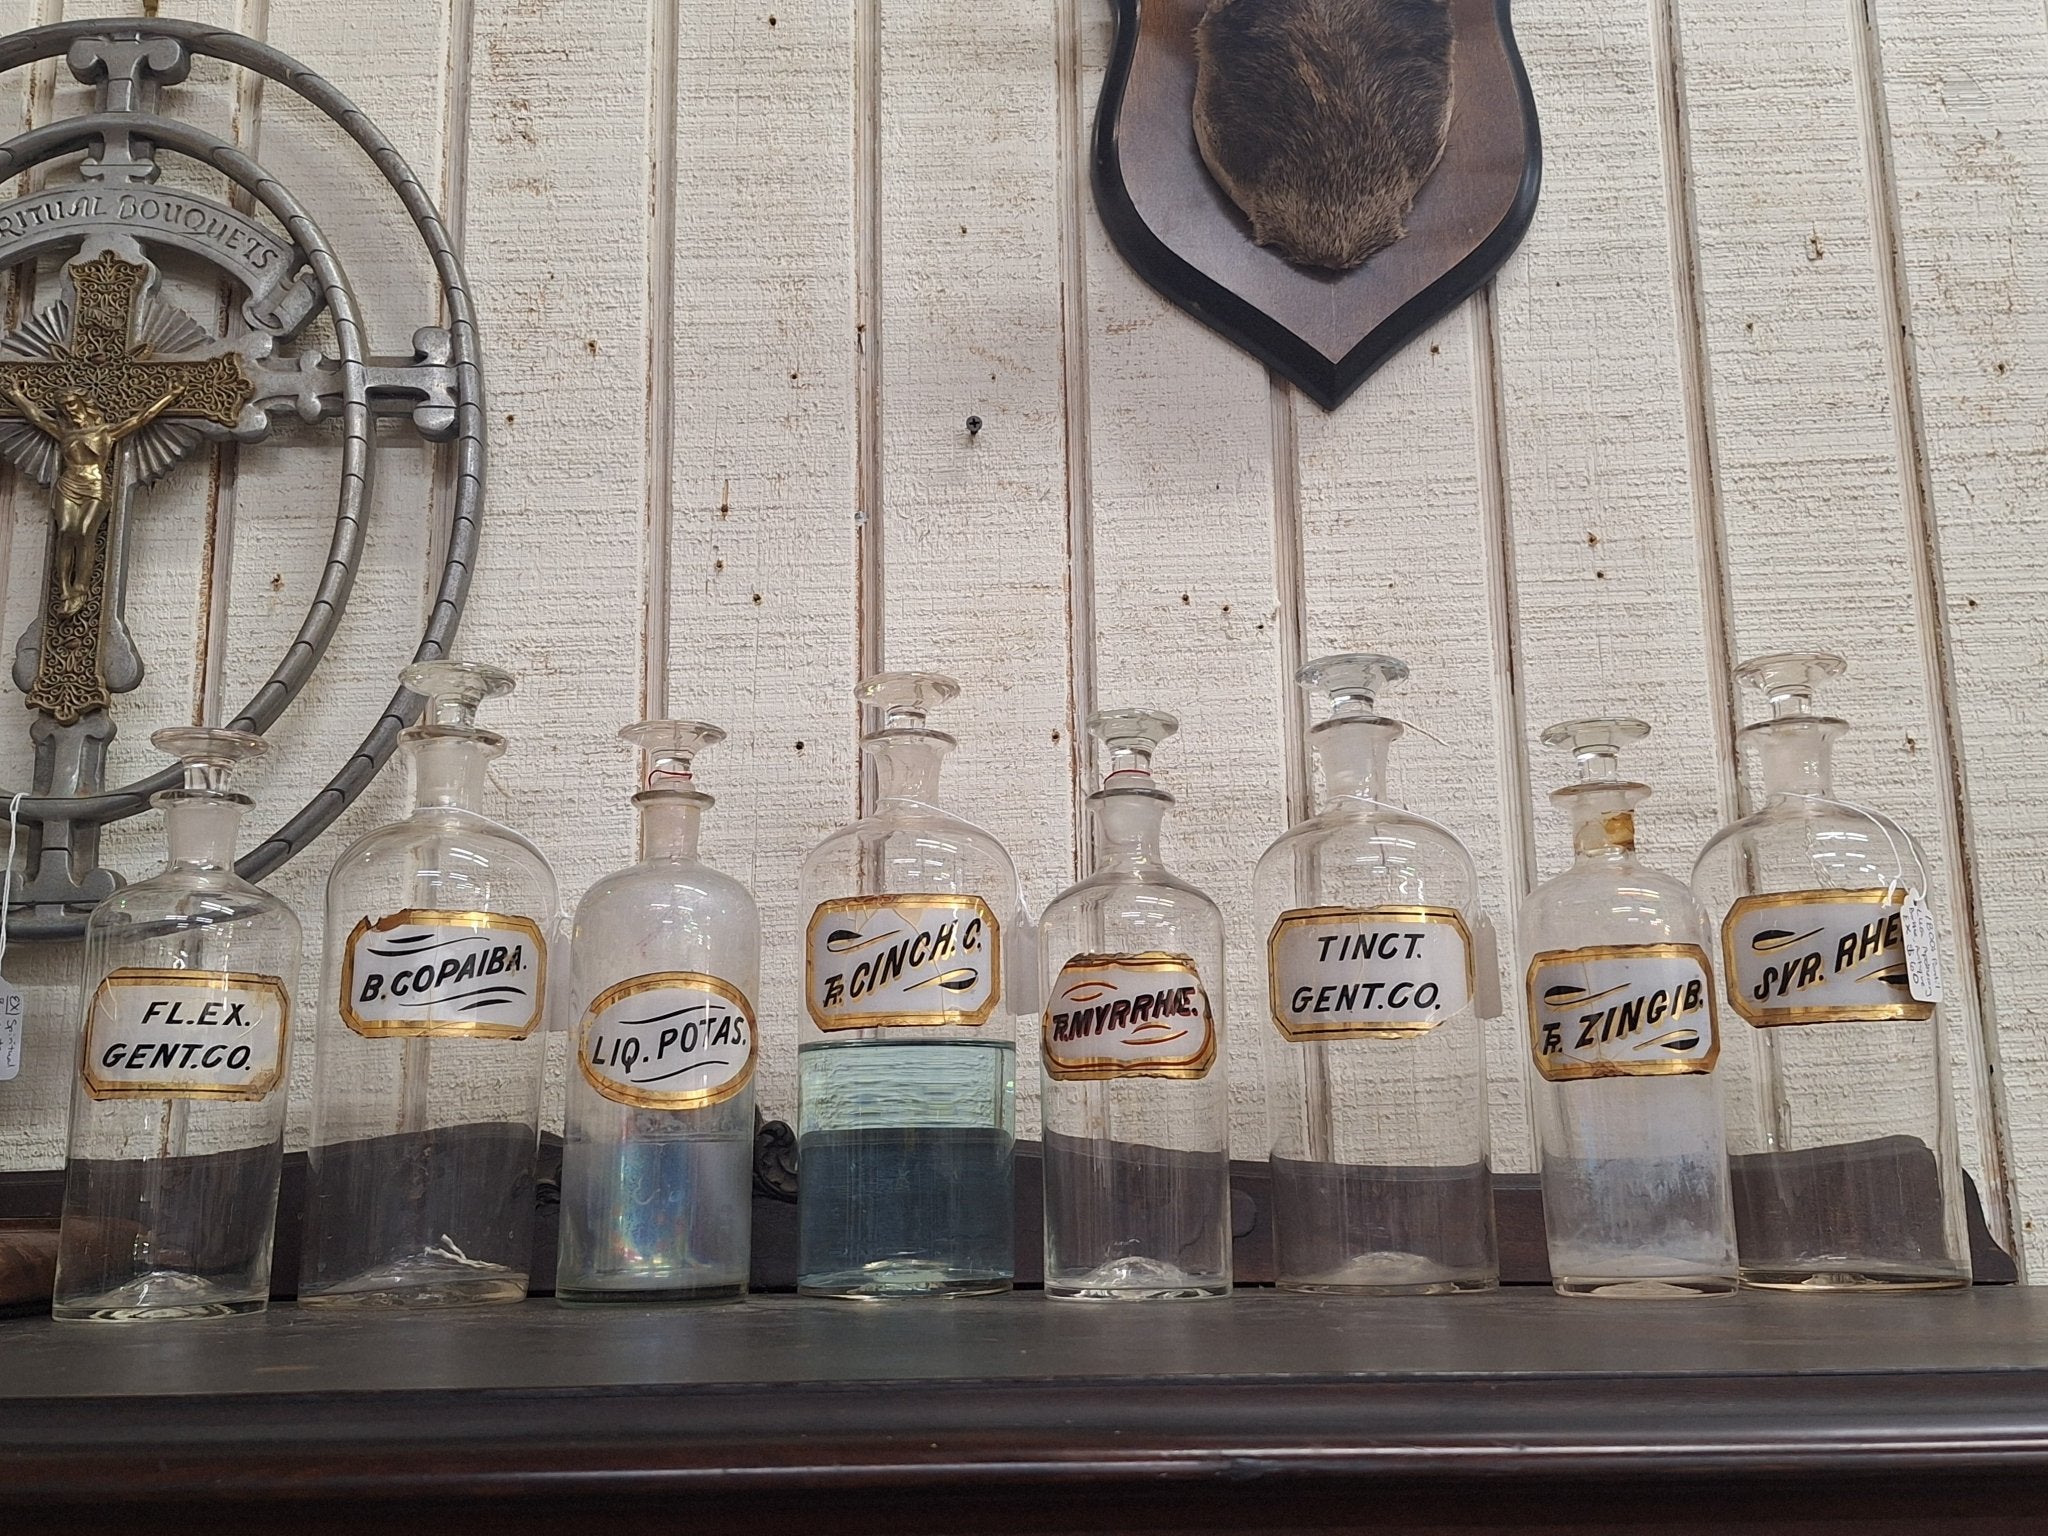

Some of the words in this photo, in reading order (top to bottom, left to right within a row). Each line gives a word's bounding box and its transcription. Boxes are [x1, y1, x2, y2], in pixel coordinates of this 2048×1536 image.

[118, 194, 279, 269] BOUQUETS
[1317, 932, 1425, 962] TINCT.
[1753, 951, 1825, 1001] SYR.
[1834, 911, 1904, 973] RHE
[5, 1019, 17, 1067] Spiritual
[591, 1035, 649, 1074] LIQ.
[657, 1015, 747, 1060] POTAS.
[1574, 979, 1704, 1050] ZINGIB.
